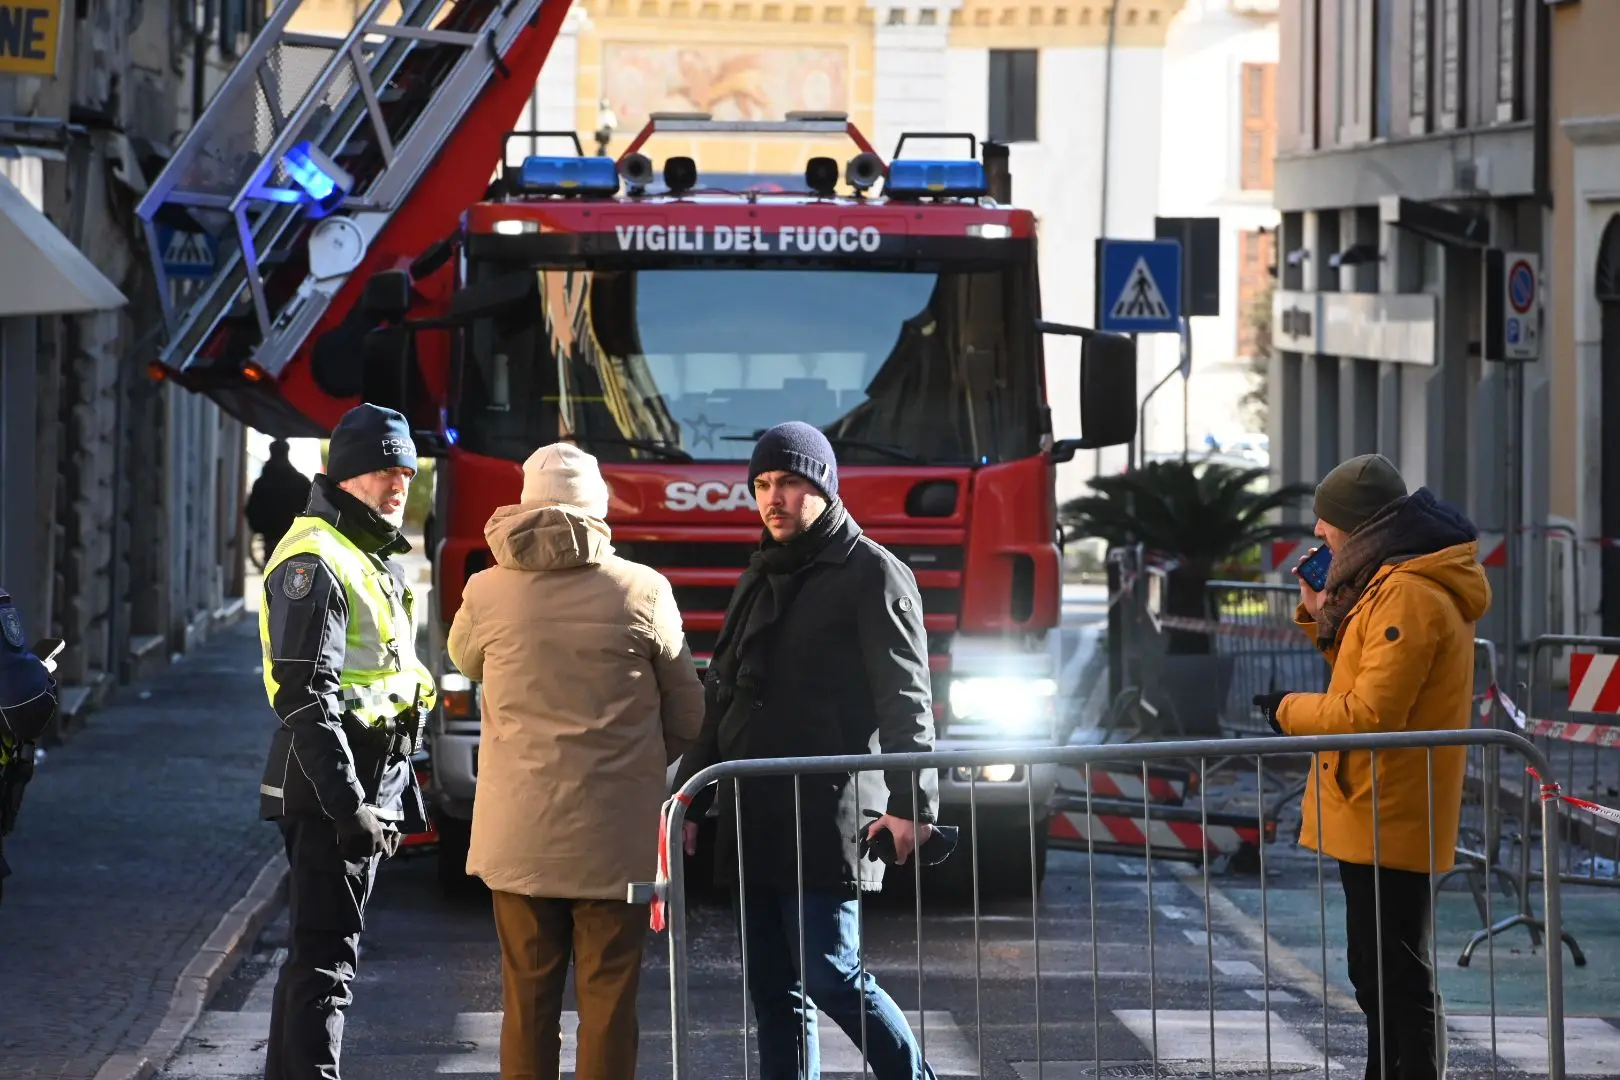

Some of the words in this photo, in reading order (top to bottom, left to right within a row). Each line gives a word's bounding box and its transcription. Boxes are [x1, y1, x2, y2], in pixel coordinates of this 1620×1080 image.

[615, 224, 704, 251] VIGILI
[713, 225, 769, 251] DEL
[778, 226, 881, 252] FUOCO
[664, 482, 758, 511] SCA
